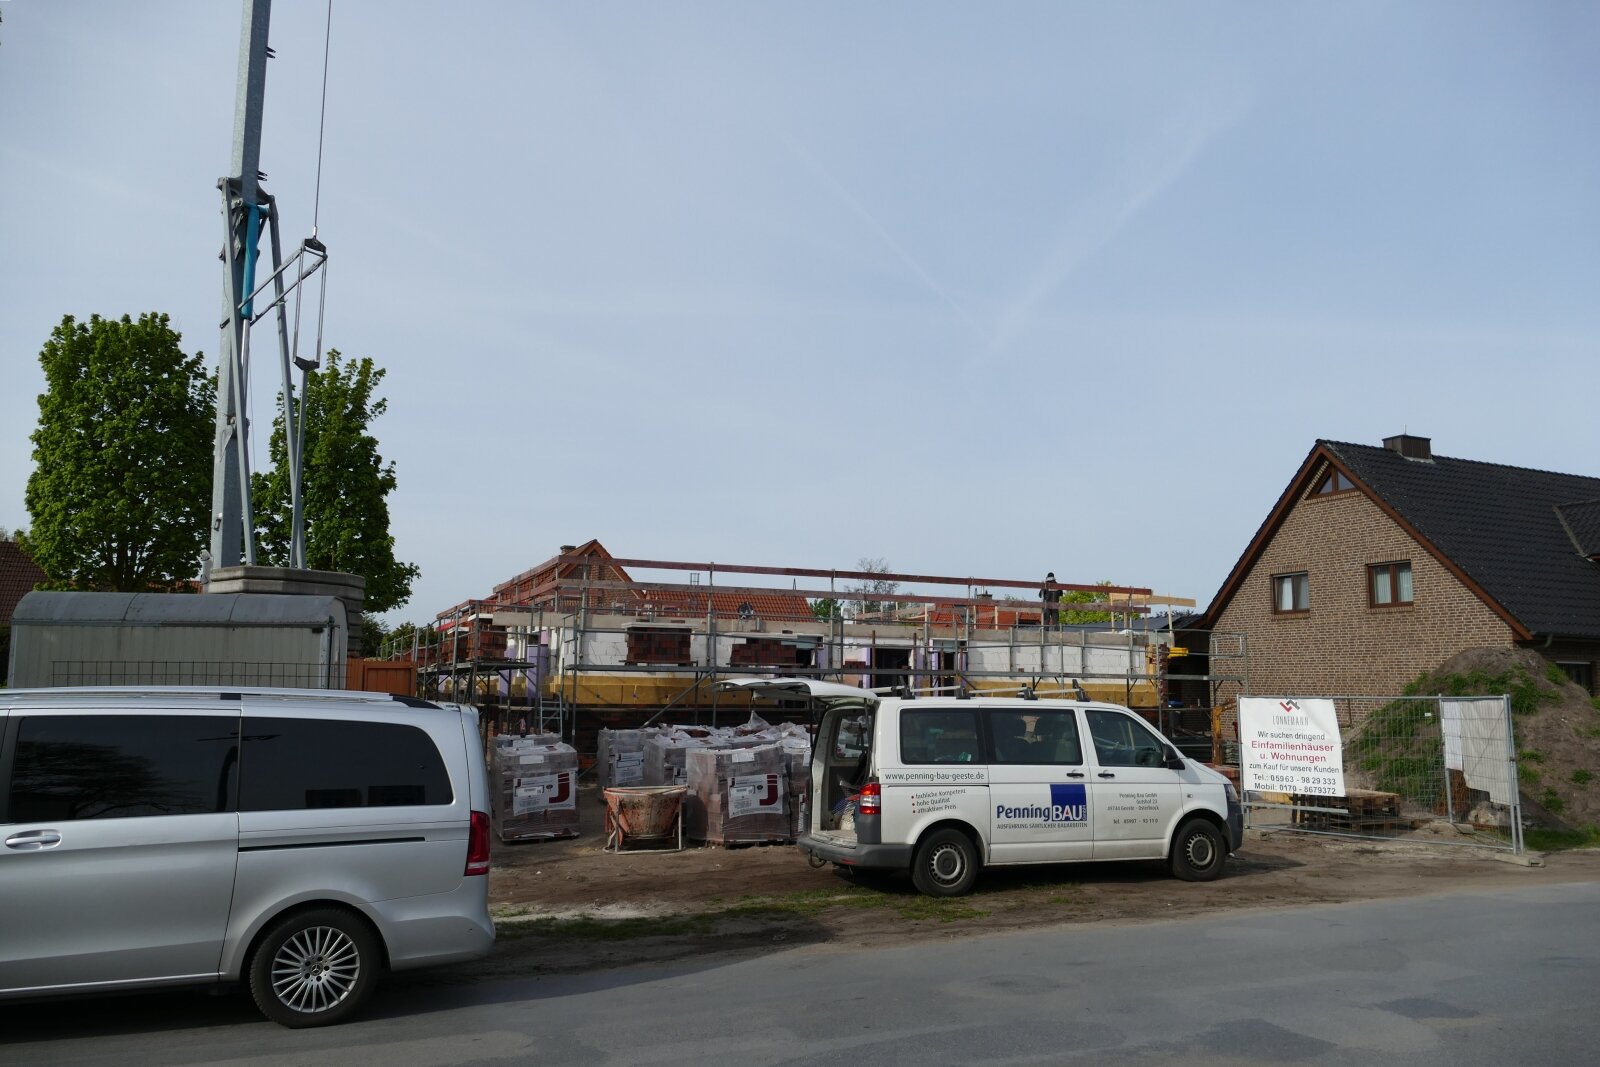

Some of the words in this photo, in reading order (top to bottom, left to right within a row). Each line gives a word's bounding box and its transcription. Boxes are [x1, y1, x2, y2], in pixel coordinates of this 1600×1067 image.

[1257, 730, 1269, 738] Wir
[1270, 731, 1293, 739] suchen
[1294, 732, 1326, 741] dringend
[1251, 740, 1334, 752] Einfamilienhäuser
[1270, 752, 1327, 764] Wohnungen
[1279, 763, 1289, 771] für
[1290, 765, 1312, 773] unsere
[1313, 765, 1340, 774] Kunden
[885, 772, 985, 782] www.penning-bau-geeste.de
[1253, 773, 1268, 781] Tel.:
[1270, 775, 1294, 783] 05963
[1301, 776, 1310, 784] 98
[1311, 777, 1321, 785] 29
[1322, 778, 1336, 786] 333
[939, 788, 966, 796] Kompetenz
[1254, 782, 1277, 790] Mobil:
[1279, 784, 1297, 792] 0170
[1303, 786, 1336, 795] 8679372
[916, 799, 930, 807] hohe
[996, 803, 1051, 822] Penning
[1052, 804, 1082, 821] BAU
